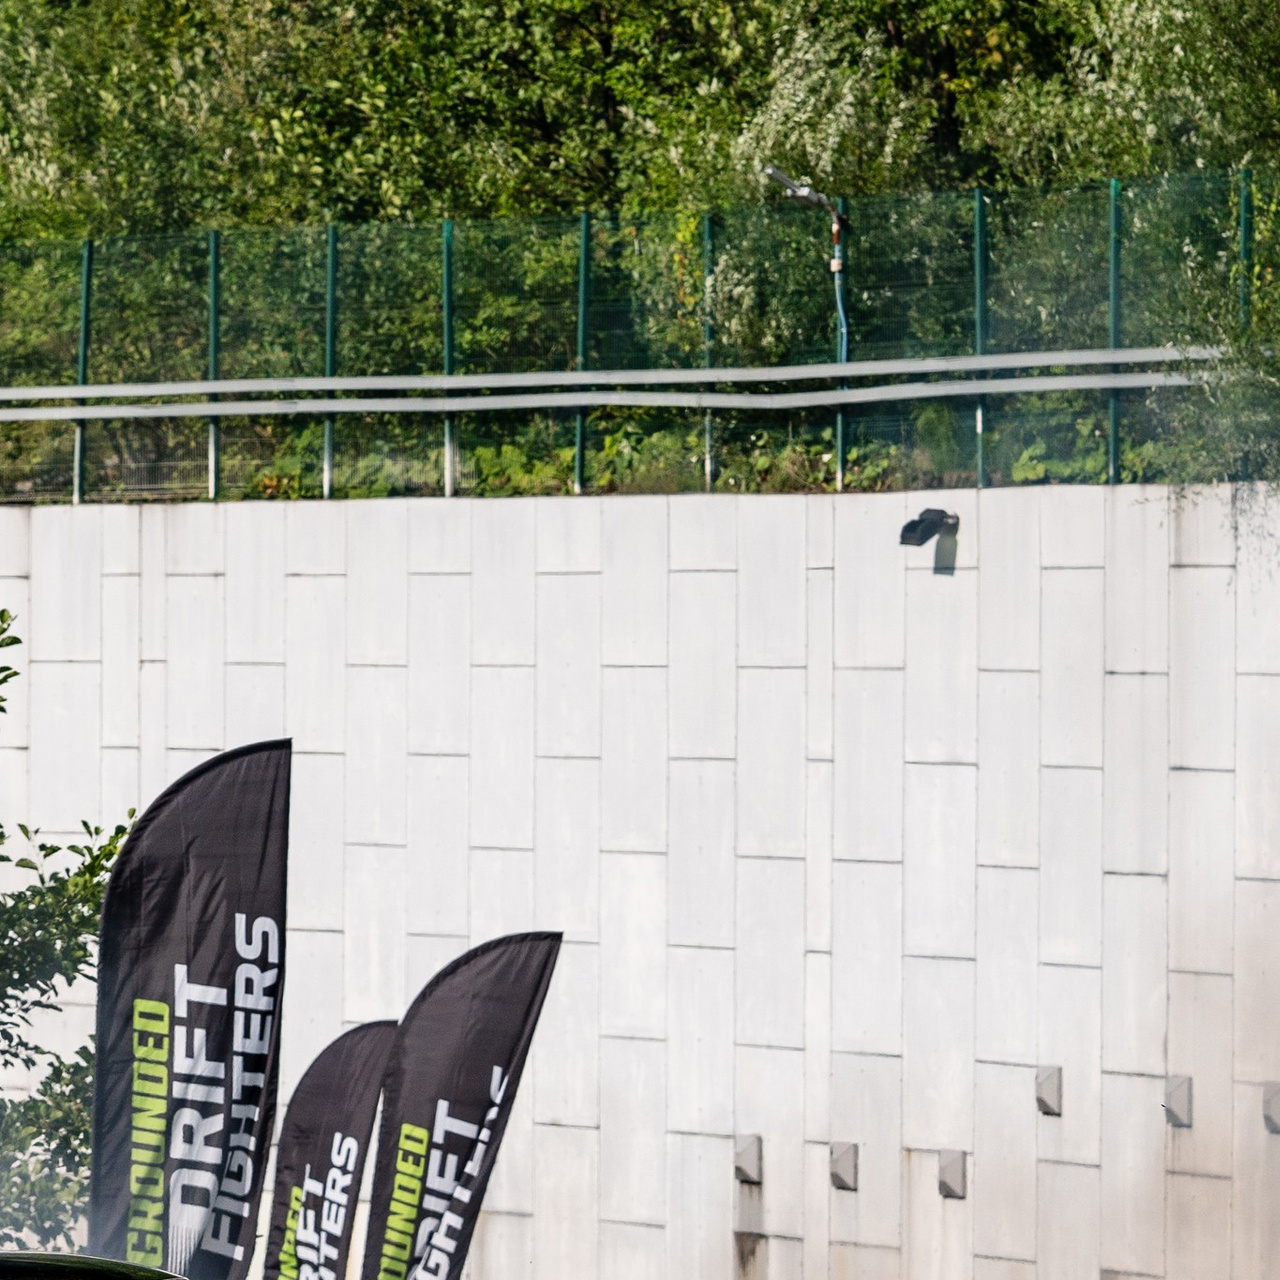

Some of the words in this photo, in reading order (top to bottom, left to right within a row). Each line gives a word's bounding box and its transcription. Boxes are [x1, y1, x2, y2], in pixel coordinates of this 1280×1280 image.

[126, 998, 170, 1268] GROUNDED
[168, 963, 227, 1275] DRIFT
[201, 913, 279, 1261] FIGHTERS
